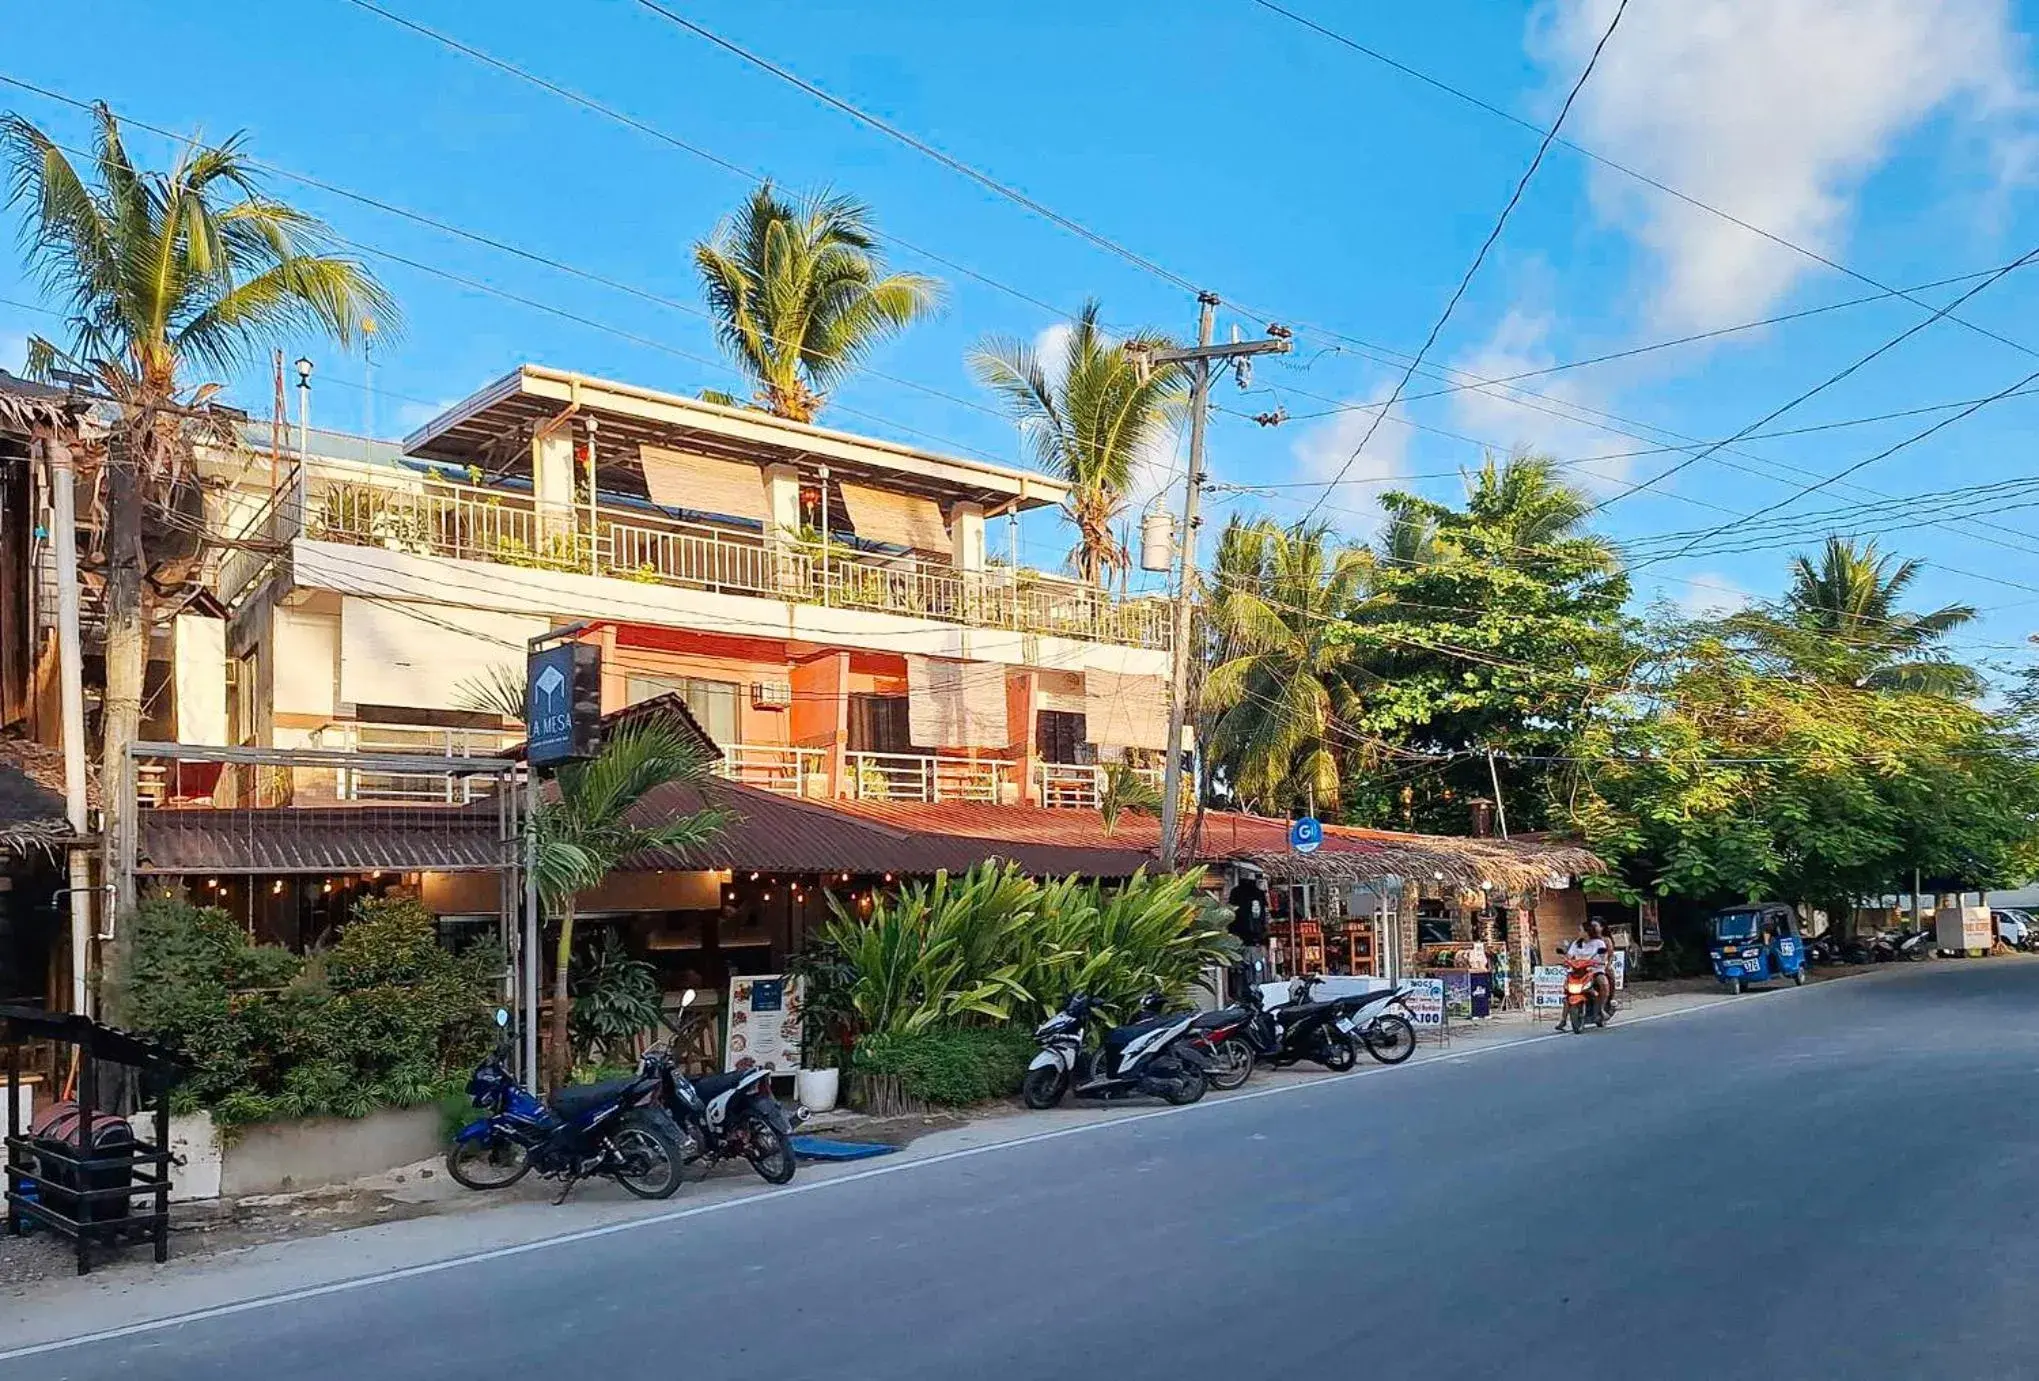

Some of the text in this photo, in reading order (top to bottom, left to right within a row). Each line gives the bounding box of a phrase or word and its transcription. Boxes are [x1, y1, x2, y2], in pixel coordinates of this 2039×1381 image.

[528, 712, 573, 739] LA MESA
[1420, 1013, 1440, 1024] 100
